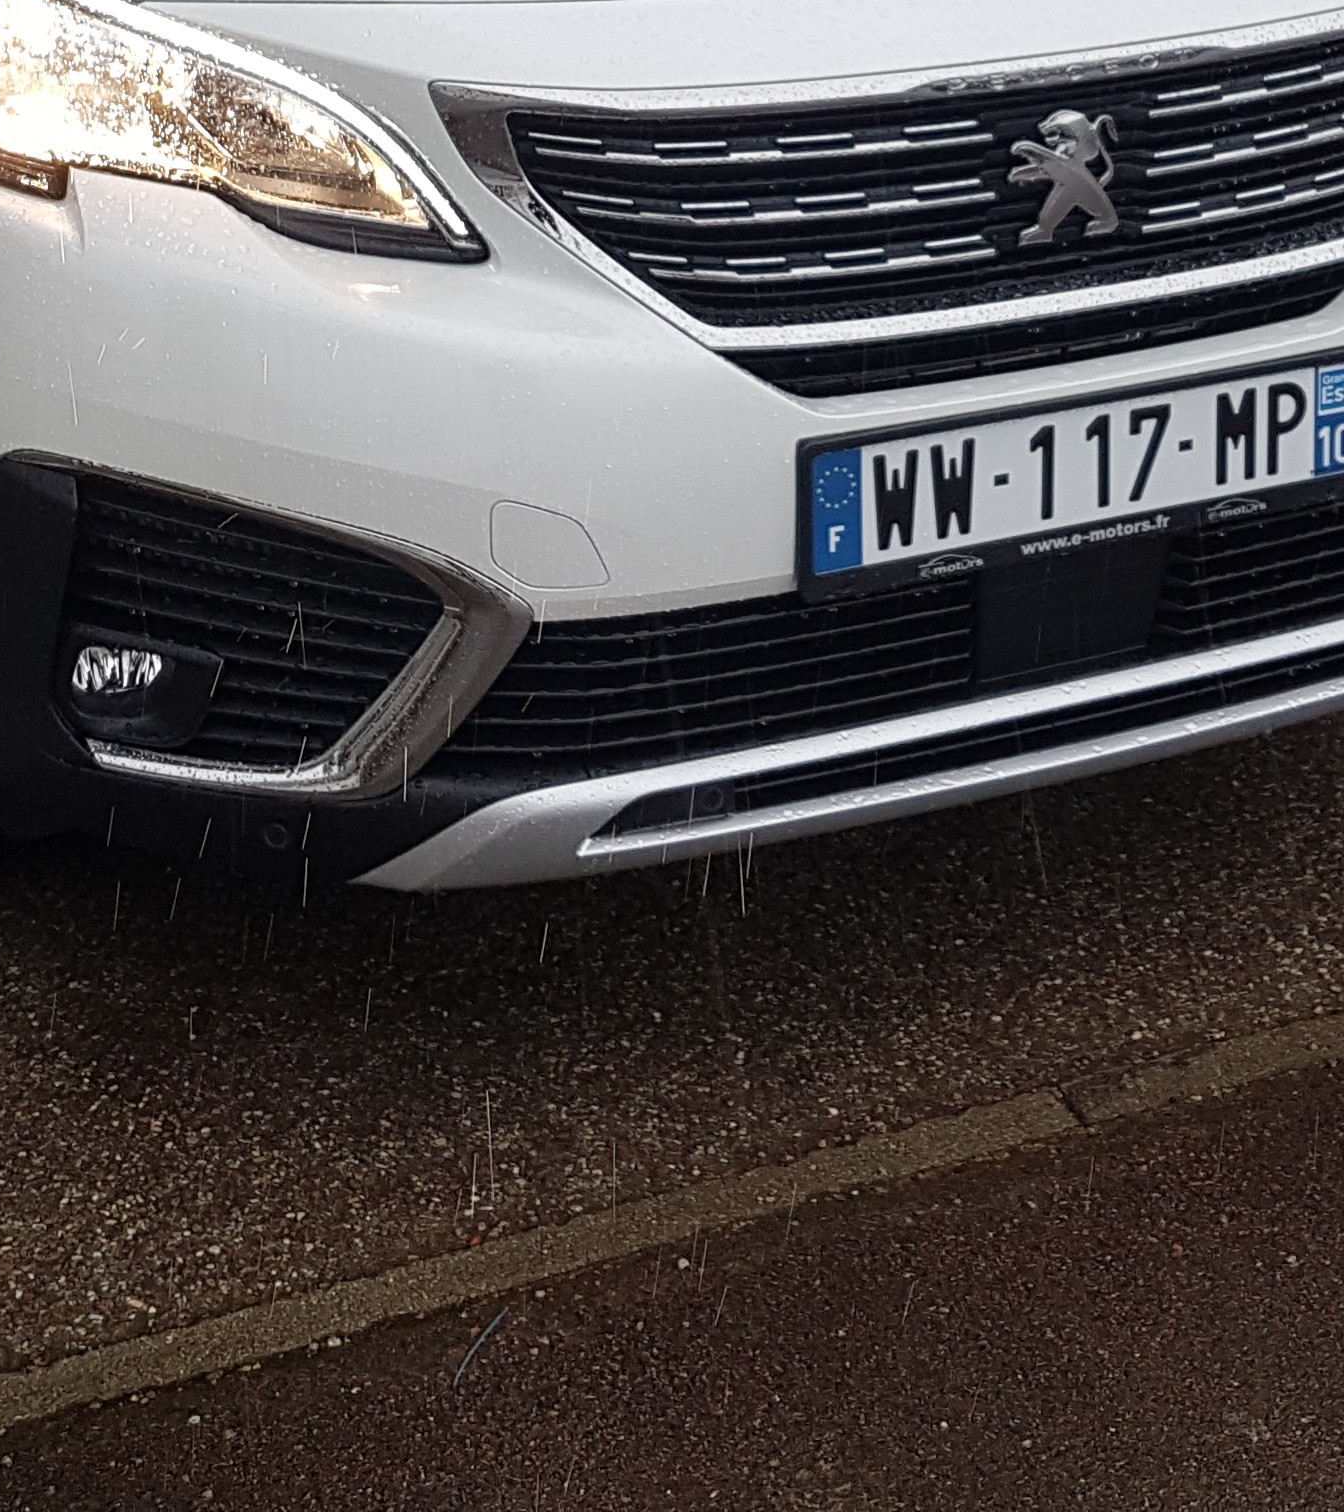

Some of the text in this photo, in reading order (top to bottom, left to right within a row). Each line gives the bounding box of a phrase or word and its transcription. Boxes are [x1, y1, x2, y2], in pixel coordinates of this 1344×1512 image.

[945, 46, 1197, 96] PEGEO
[828, 524, 846, 554] F
[1020, 514, 1171, 556] www.e-motors.fr
